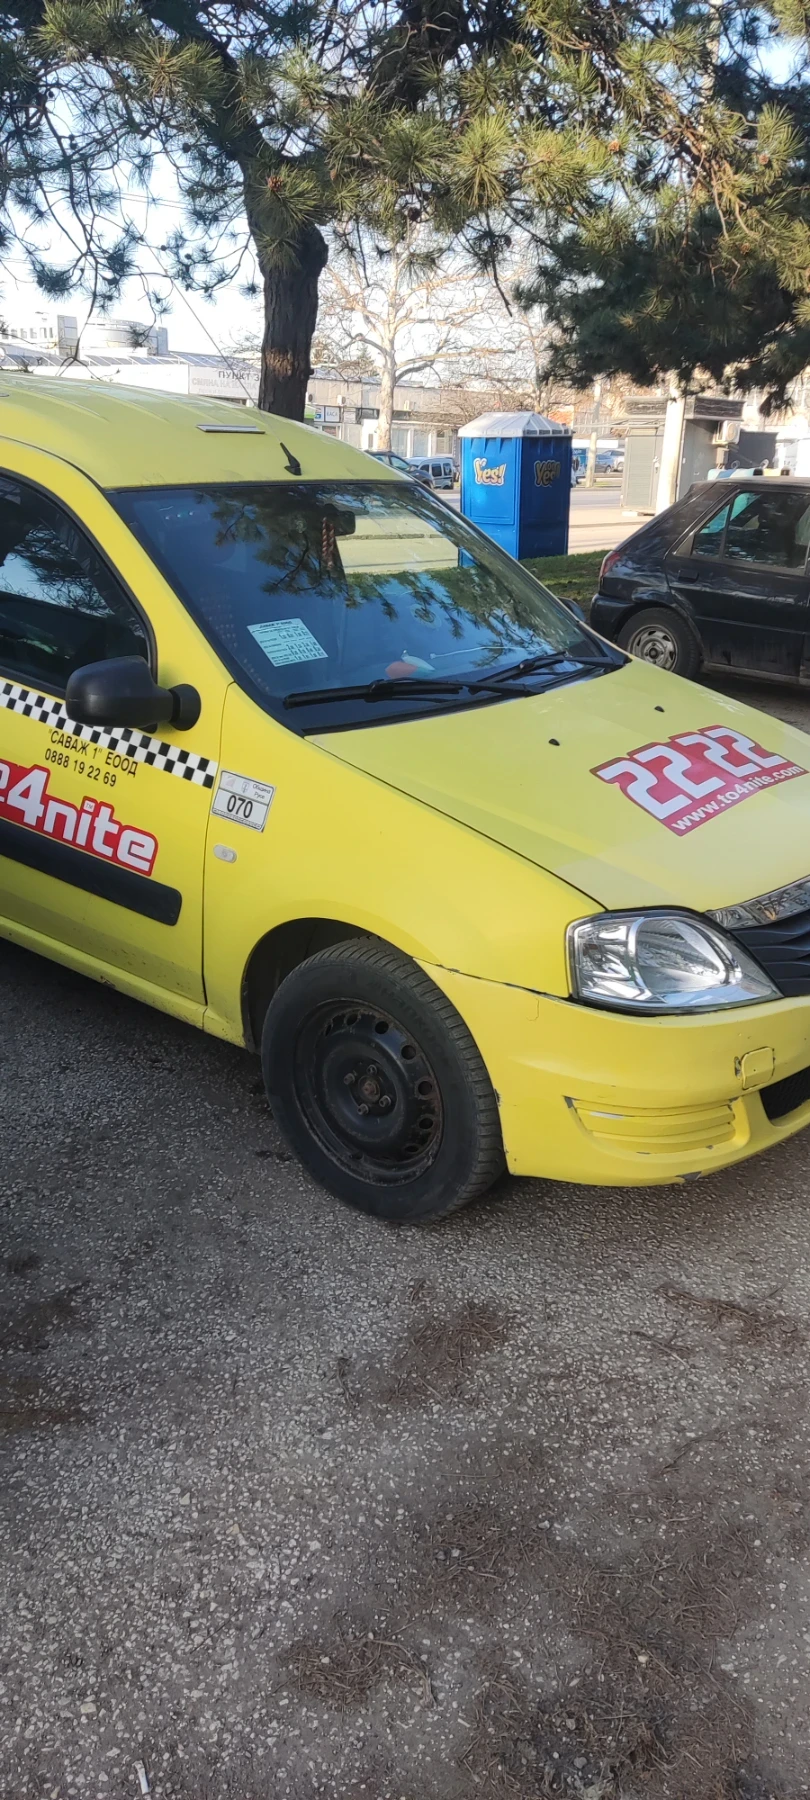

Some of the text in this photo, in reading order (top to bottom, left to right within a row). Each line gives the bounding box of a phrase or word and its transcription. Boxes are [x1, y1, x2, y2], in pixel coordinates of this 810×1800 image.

[474, 457, 506, 486] Yes!
[45, 748, 117, 787] 0888 19 22 69
[105, 751, 138, 778] ЕООД
[596, 727, 788, 820] 2222
[226, 794, 253, 819] 070
[671, 766, 804, 830] www.to4nite.com
